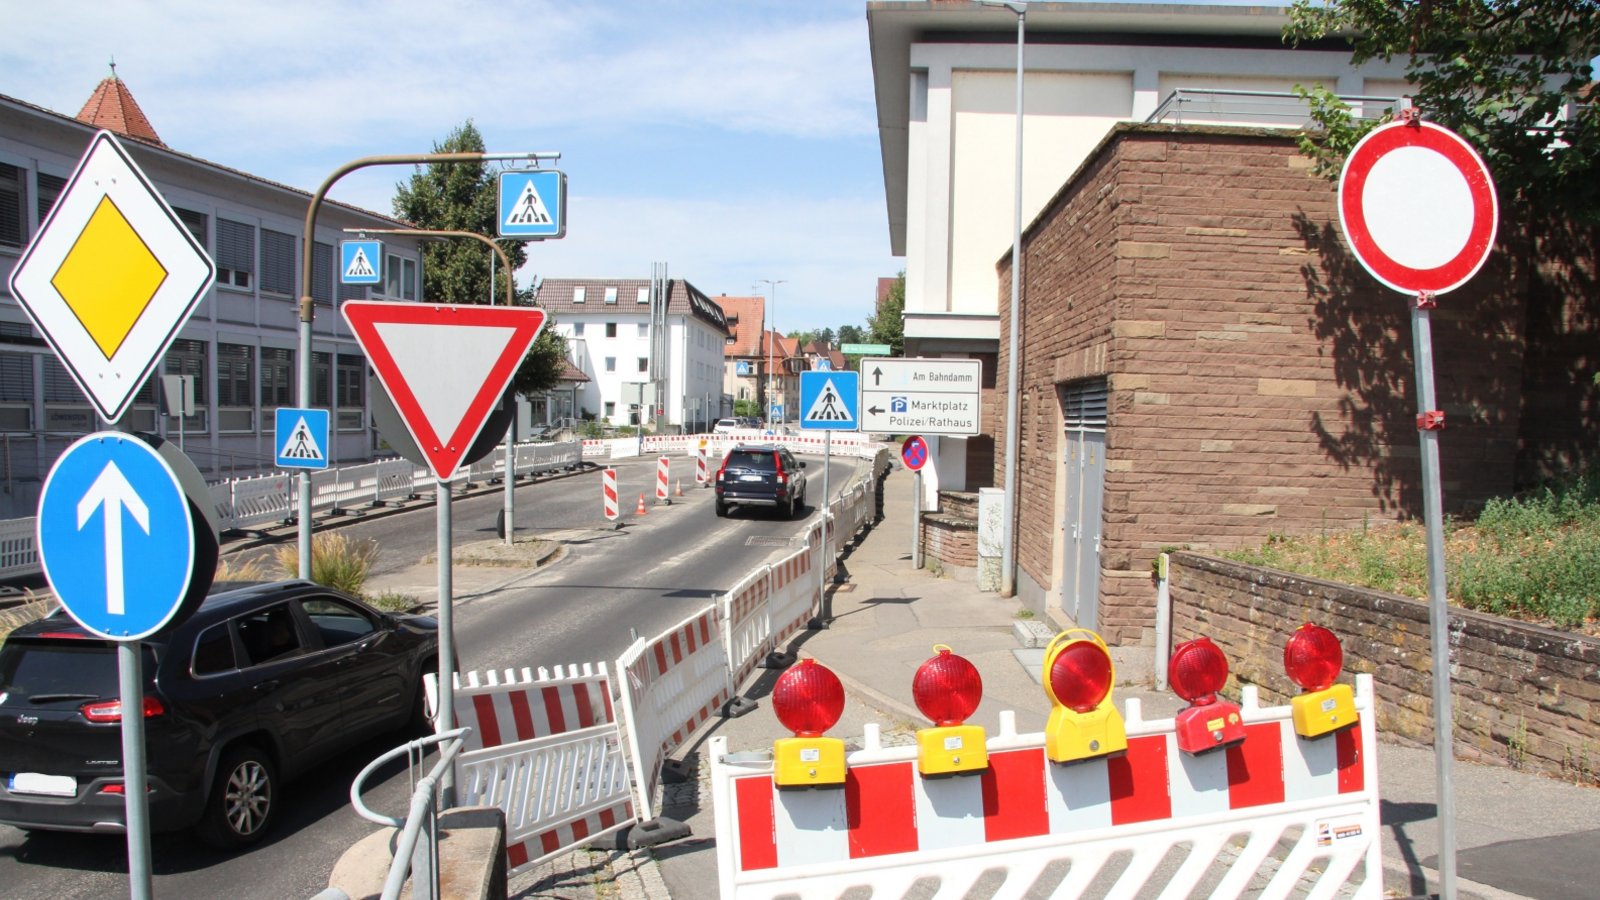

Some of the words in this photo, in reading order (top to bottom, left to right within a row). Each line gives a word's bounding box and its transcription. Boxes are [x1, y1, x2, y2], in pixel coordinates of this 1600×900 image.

[913, 372, 925, 381] Am
[929, 372, 972, 382] Bahndamm
[911, 400, 968, 412] Marktplatz
[889, 416, 972, 428] Polizei/Rathaus
[17, 714, 39, 725] Jeep
